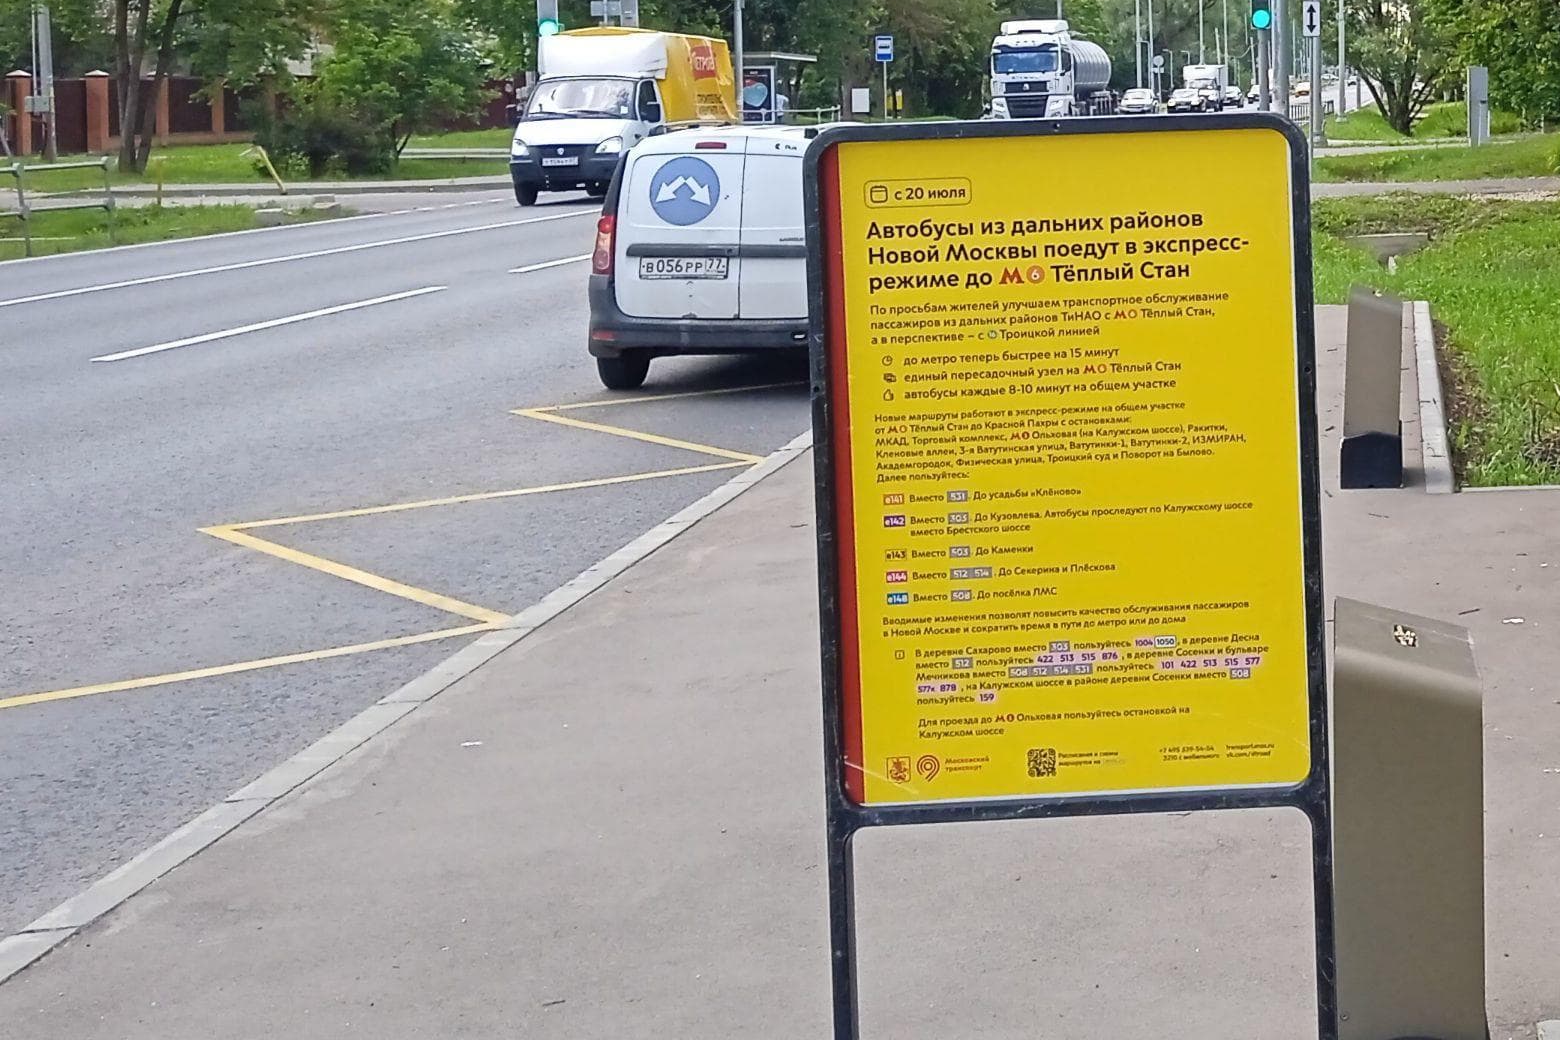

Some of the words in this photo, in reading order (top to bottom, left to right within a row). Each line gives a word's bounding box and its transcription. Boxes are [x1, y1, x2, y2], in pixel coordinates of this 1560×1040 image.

[893, 190, 902, 201] с
[904, 186, 924, 200] 20
[927, 187, 966, 199] июля
[865, 218, 974, 240] Автобусы
[980, 220, 1005, 235] из
[1010, 216, 1104, 237] дальних
[1109, 210, 1203, 233] районов
[867, 244, 939, 265] Новой
[944, 242, 1037, 262] Москвы
[1043, 241, 1120, 259] поедут
[1124, 240, 1138, 255] в
[1142, 236, 1249, 255] экспресс-
[868, 273, 960, 294] режиме
[964, 271, 993, 290] до
[1049, 261, 1134, 283] Тёплый
[1139, 260, 1190, 279] Стан
[869, 304, 887, 315] По
[888, 301, 948, 316] просьбам
[949, 299, 1000, 312] жителей
[1001, 299, 1061, 312] улучшаем
[1062, 295, 1143, 309] транспортное
[1144, 292, 1229, 305] обслуживание
[869, 319, 941, 330] пассажиров
[942, 318, 957, 327] из
[958, 316, 1007, 328] дальних
[1008, 313, 1058, 327] районов
[1060, 309, 1102, 322] ТиНАО
[1139, 306, 1183, 319] Тёплый
[1184, 305, 1215, 317] Стан,
[889, 332, 965, 346] перспективе
[998, 326, 1055, 342] Троицкой
[1057, 325, 1100, 337] линией
[902, 356, 918, 366] до
[919, 354, 958, 366] метро
[958, 353, 1000, 364] теперь
[1001, 349, 1051, 363] быстрее
[1053, 350, 1068, 359] на
[1069, 346, 1082, 358] 15
[1083, 347, 1120, 359] минут
[903, 370, 948, 384] единый
[950, 366, 1035, 382] пересадочный
[1036, 367, 1064, 379] узел
[1065, 366, 1080, 375] на
[1108, 361, 1153, 373] Тёплый
[1154, 360, 1182, 372] Стан
[903, 387, 958, 400] автобусы
[960, 386, 1006, 397] каждые
[1007, 382, 1033, 395] 8-10
[1035, 383, 1071, 395] минут
[1072, 383, 1087, 392] на
[1088, 379, 1131, 392] общем
[1131, 379, 1177, 392] участке
[873, 413, 907, 423] Новые
[907, 412, 959, 422] маршруты
[959, 408, 1006, 420] работают
[1015, 405, 1100, 417] экспресс-режиме
[1113, 402, 1148, 412] общем
[1149, 401, 1186, 413] участке
[908, 422, 945, 433] Тёплый
[945, 421, 969, 432] Стан
[984, 419, 1025, 431] Красной
[1026, 418, 1059, 429] Пахры
[911, 434, 957, 446] Торговый
[1031, 430, 1078, 440] Ольховая
[1094, 427, 1150, 438] Калужском
[875, 449, 924, 459] Кленовые
[976, 444, 1035, 456] Ватутинская
[954, 457, 1013, 467] Физическая
[1046, 451, 1093, 464] Троицкий
[1119, 449, 1162, 460] Поворот
[875, 473, 907, 484] Далее
[908, 493, 945, 503] Вместо
[988, 488, 1029, 501] усадьбы
[909, 515, 946, 525] Вместо
[1043, 507, 1090, 519] Автобусы
[1090, 506, 1148, 518] проследуют
[1162, 503, 1223, 514] Калужскому
[1223, 501, 1253, 510] шоссе
[909, 527, 945, 537] вместо
[945, 525, 1000, 537] Брестского
[1000, 523, 1031, 533] шоссе
[910, 549, 947, 559] Вместо
[990, 545, 1034, 554] Каменки
[1013, 565, 1060, 576] Секерина
[881, 616, 933, 626] Вводимые
[933, 613, 987, 623] изменения
[987, 611, 1031, 620] позволят
[1032, 609, 1078, 618] повысить
[1078, 606, 1121, 616] качество
[1122, 603, 1191, 615] обслуживания
[1192, 600, 1250, 611] пассажиров
[890, 626, 922, 637] Новой
[922, 626, 962, 636] Москве
[970, 623, 1019, 634] сократить
[1019, 622, 1051, 632] время
[1096, 618, 1127, 628] метро
[922, 648, 964, 659] деревне
[964, 645, 1012, 656] Сахарово
[1012, 644, 1047, 653] вместо
[1072, 639, 1131, 651] пользуйтесь
[1188, 635, 1229, 645] деревне
[1230, 632, 1260, 643] Десна
[914, 661, 950, 670] вместо
[975, 656, 1034, 667] пользуйтесь
[1133, 649, 1174, 660] деревне
[1174, 646, 1215, 657] Сосенки
[1224, 644, 1269, 656] бульваре
[915, 671, 970, 682] Мечникова
[971, 670, 1006, 679] вместо
[1095, 662, 1155, 674] пользуйтесь
[978, 680, 1034, 691] Калужском
[1034, 679, 1065, 688] шоссе
[1073, 676, 1109, 687] районе
[1109, 674, 1151, 685] деревни
[1151, 671, 1192, 682] Сосенки
[1193, 670, 1227, 680] вместо
[916, 694, 976, 706] пользуйтесь
[979, 693, 995, 702] 159
[939, 716, 979, 727] проезда
[1015, 712, 1062, 722] Ольховая
[1063, 709, 1122, 720] пользуйтесь
[1122, 705, 1177, 717] остановкой
[918, 729, 974, 740] Калужском
[974, 727, 1005, 736] шоссе
